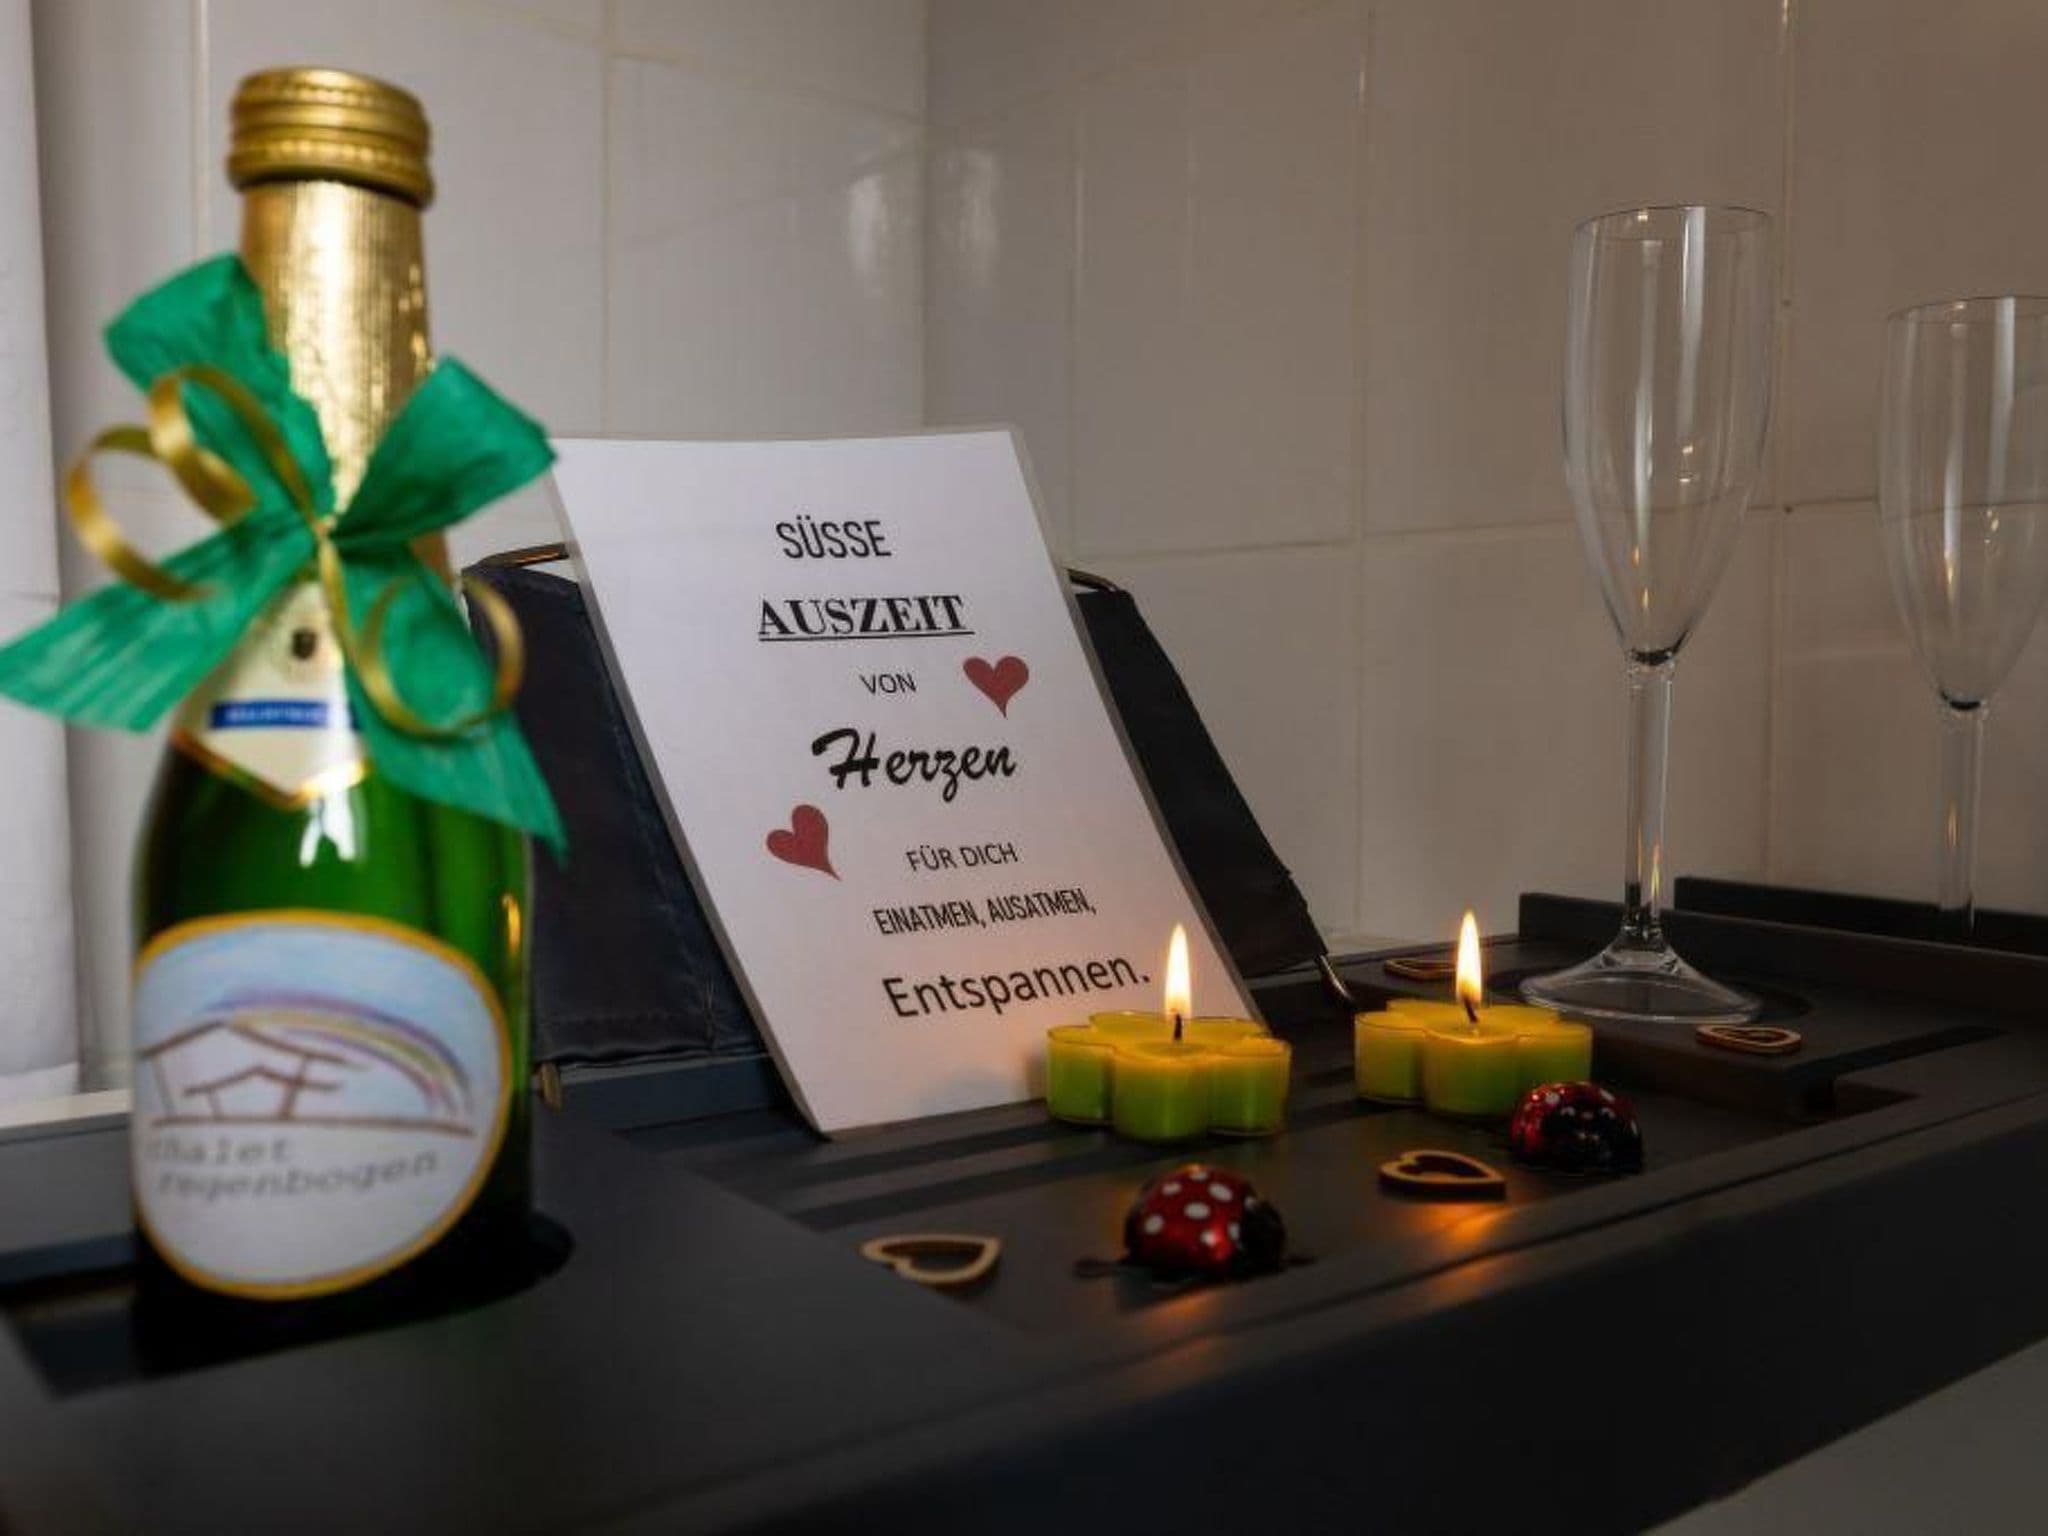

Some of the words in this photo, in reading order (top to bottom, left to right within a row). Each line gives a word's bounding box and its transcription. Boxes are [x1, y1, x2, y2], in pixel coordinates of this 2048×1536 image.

[776, 515, 891, 558] SÜSSE
[758, 595, 972, 641] AUSZEIT
[861, 673, 917, 694] VON
[811, 728, 1016, 802] Herzen
[906, 845, 957, 872] FÜR
[960, 842, 1018, 867] DICH
[872, 900, 986, 935] EINATMEN,
[987, 888, 1097, 923] AUSATMEN,
[882, 955, 1150, 1018] Entspannen.
